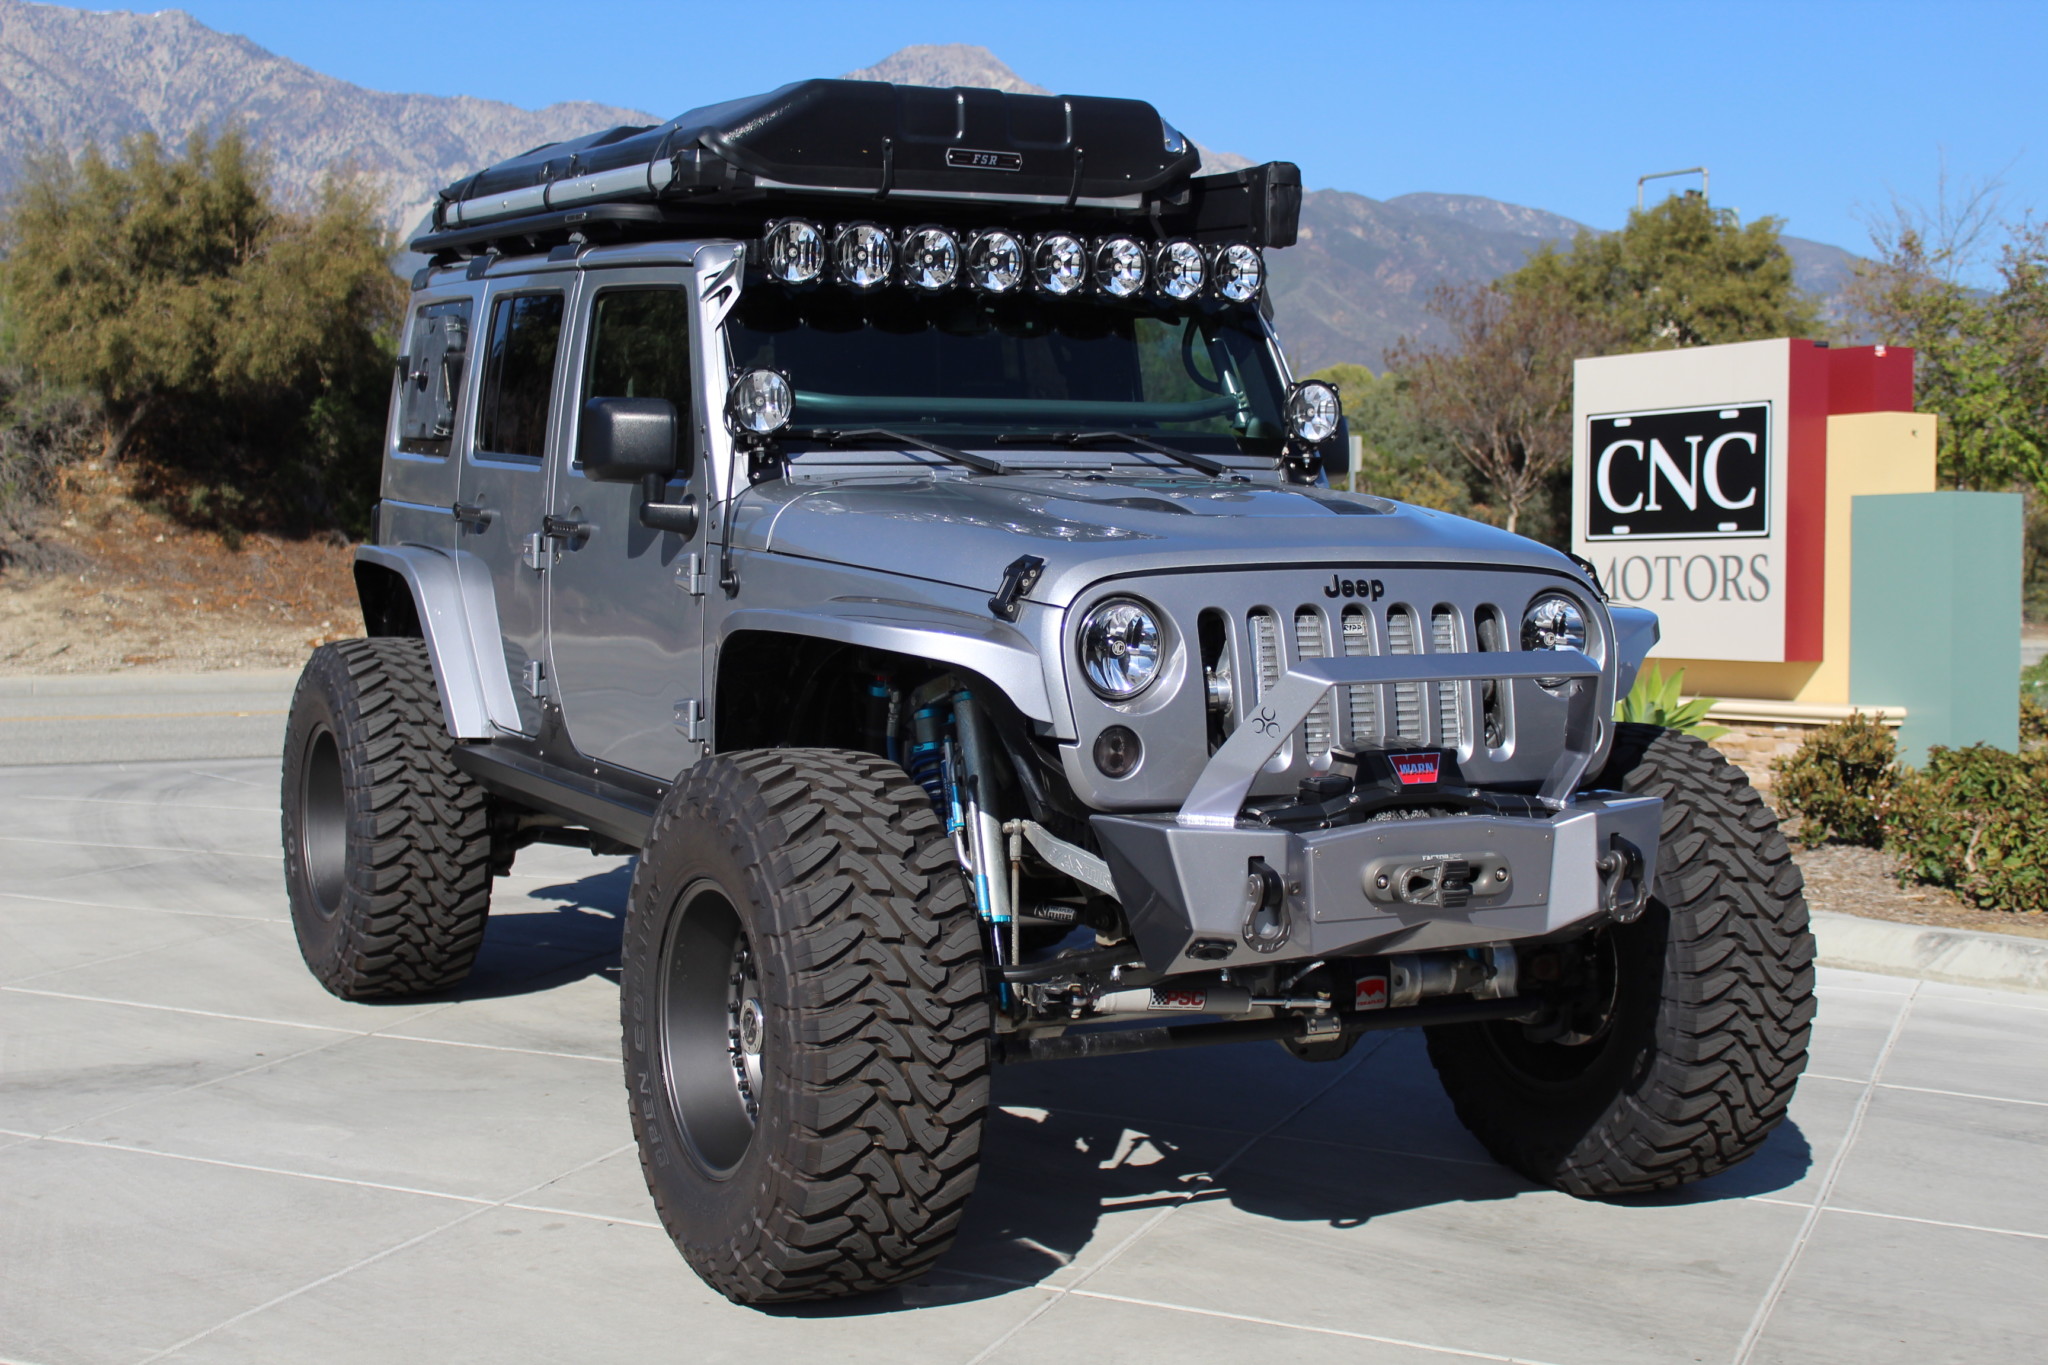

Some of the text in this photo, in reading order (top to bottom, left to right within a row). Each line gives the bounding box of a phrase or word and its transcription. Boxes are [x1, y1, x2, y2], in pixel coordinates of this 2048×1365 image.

[972, 154, 998, 166] FSR
[1597, 431, 1757, 514] CNC
[1323, 574, 1384, 602] Jeep
[1400, 762, 1434, 775] WARN
[1163, 990, 1206, 1006] PSC
[637, 1071, 670, 1169] OPEN
